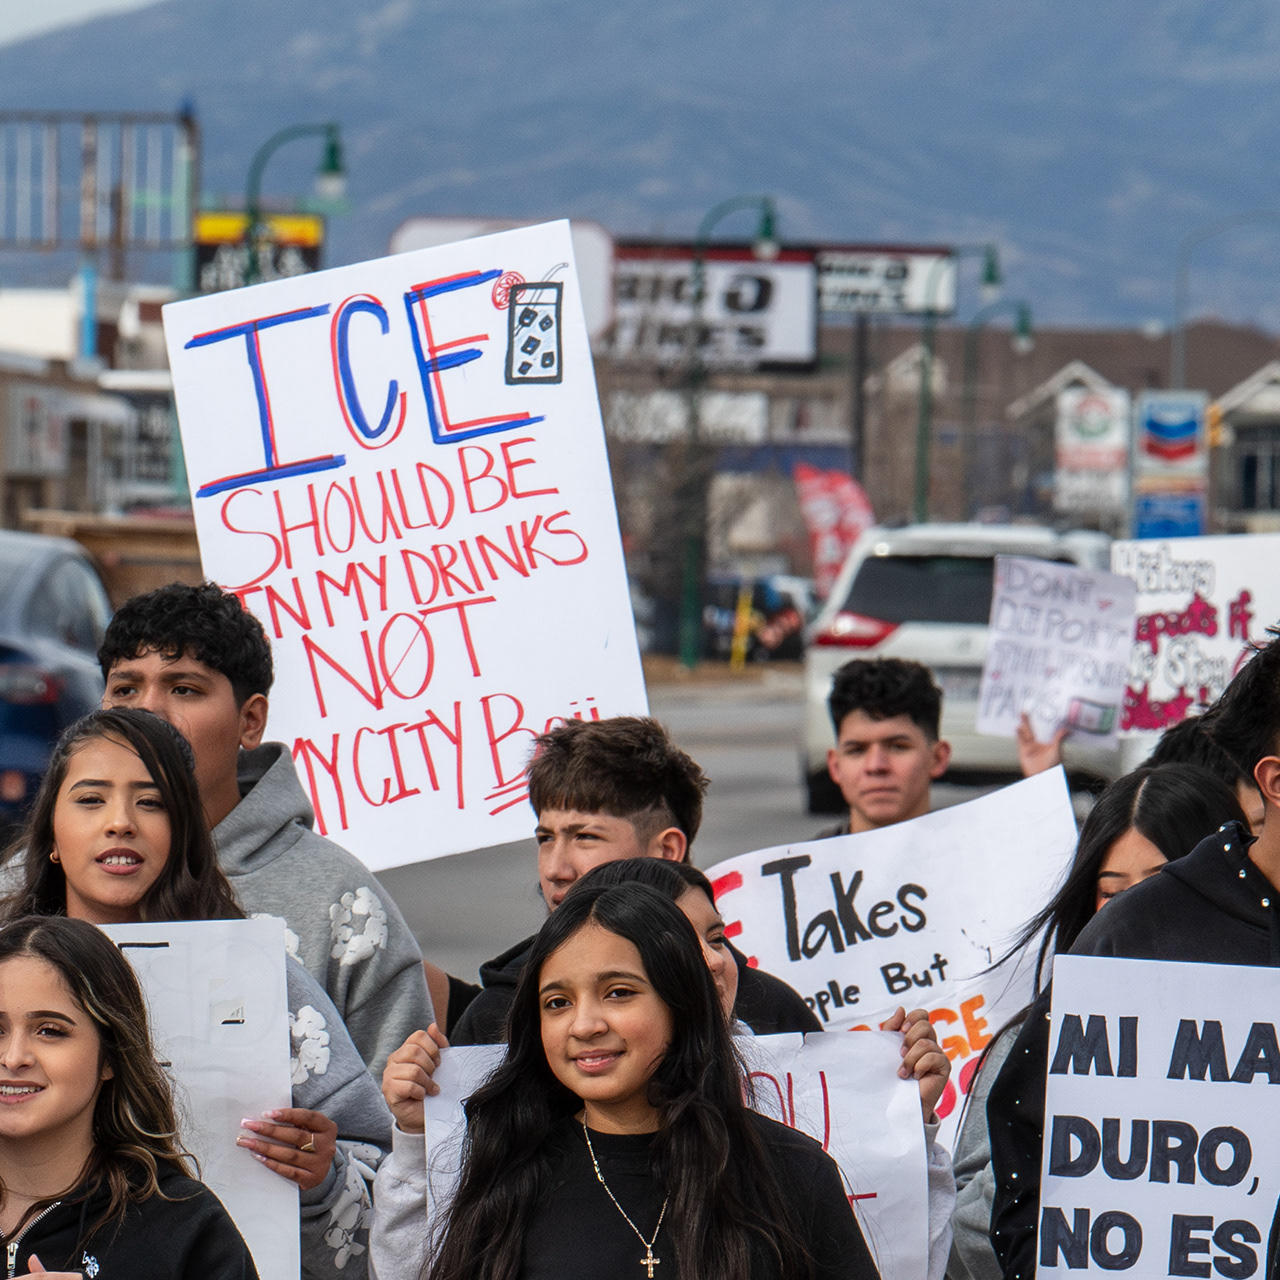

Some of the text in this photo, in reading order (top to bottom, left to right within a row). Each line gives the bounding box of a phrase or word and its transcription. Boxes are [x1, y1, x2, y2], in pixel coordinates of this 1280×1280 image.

[184, 269, 546, 498] ICE
[220, 436, 560, 589] SHOULD BE
[315, 554, 389, 628] MY
[400, 510, 589, 606] DRINKS
[301, 595, 498, 719] NOT
[352, 700, 466, 810] CITY
[760, 855, 928, 962] Takes
[880, 952, 949, 995] But
[1050, 1012, 1138, 1078] MI
[1048, 1114, 1260, 1196] DURO,
[1039, 1206, 1262, 1280] NO ES
